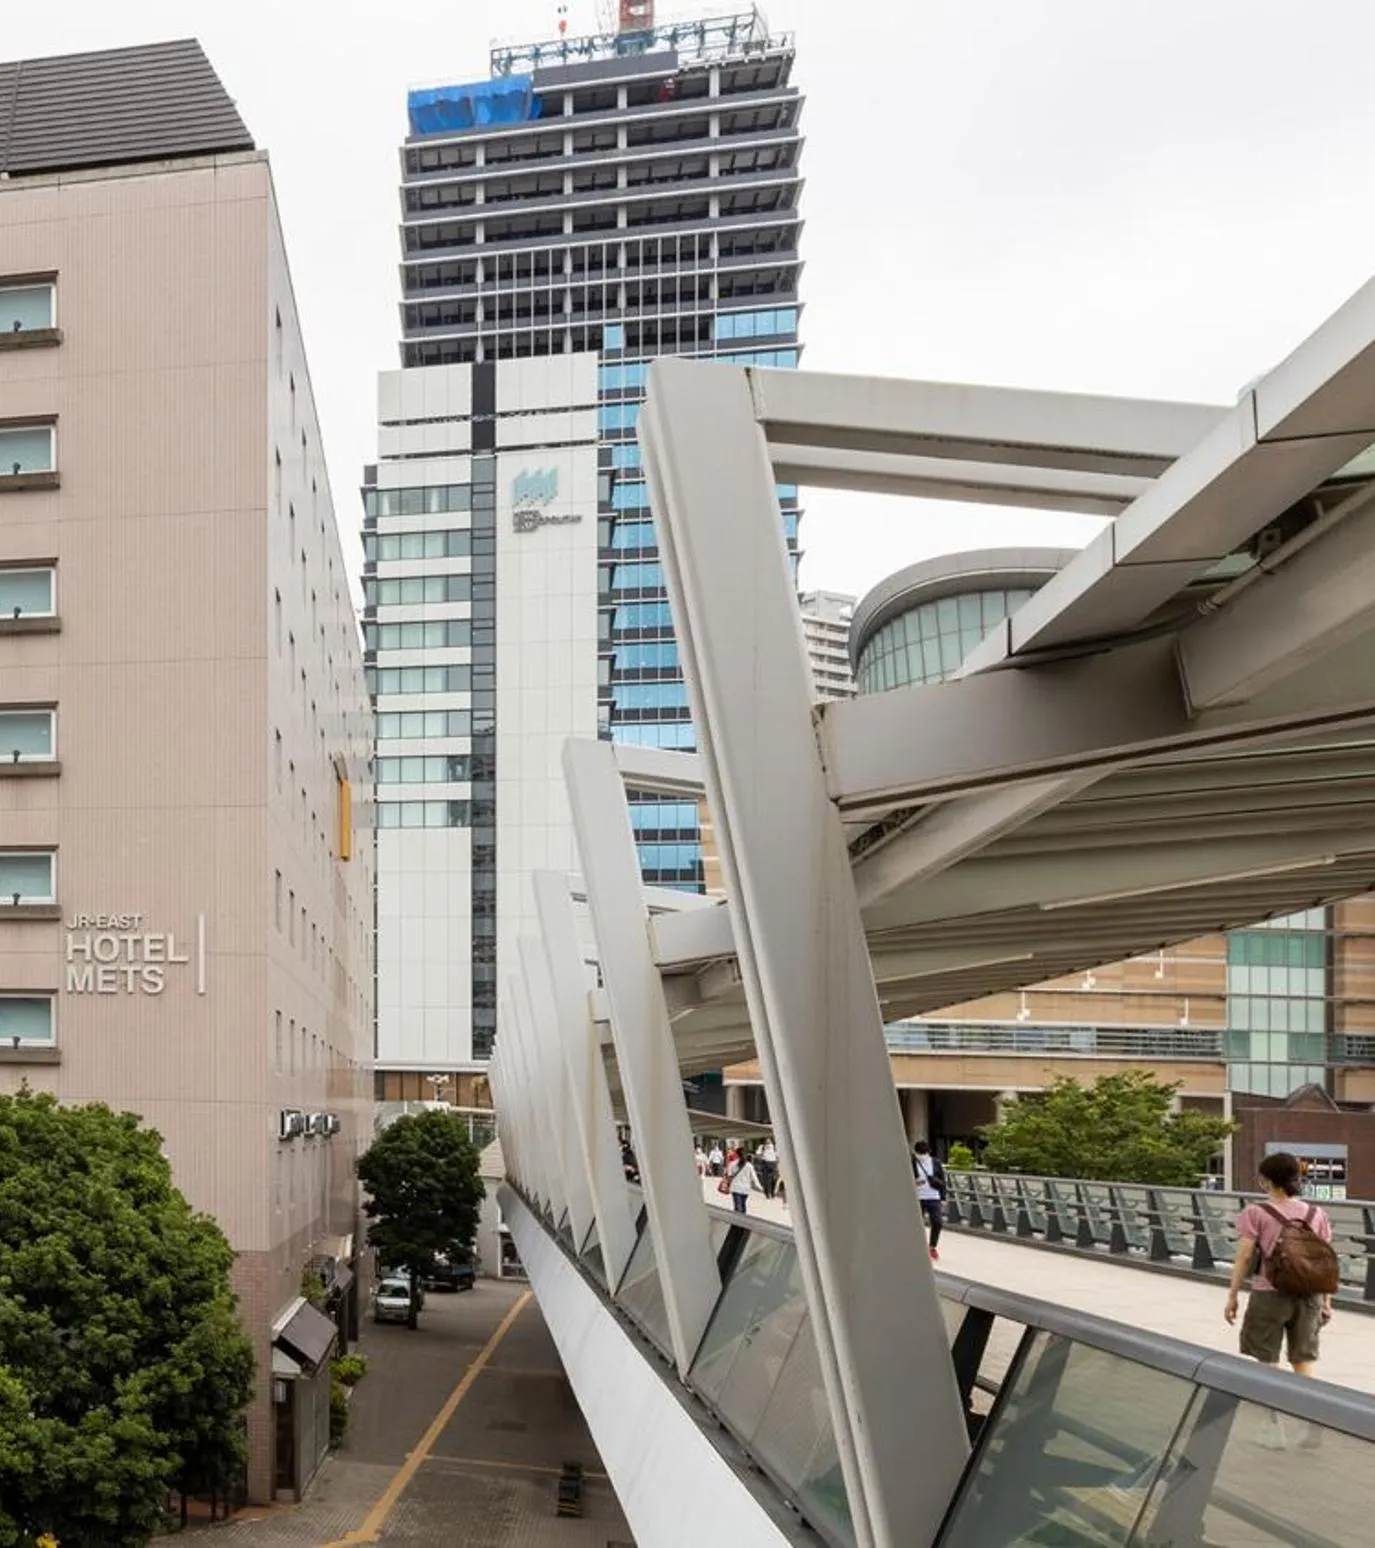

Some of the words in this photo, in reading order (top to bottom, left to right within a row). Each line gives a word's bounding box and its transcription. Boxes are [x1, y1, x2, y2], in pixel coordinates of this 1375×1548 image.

[66, 912, 143, 930] JR-EAST
[66, 932, 189, 964] HOTEL
[66, 964, 165, 996] METS
